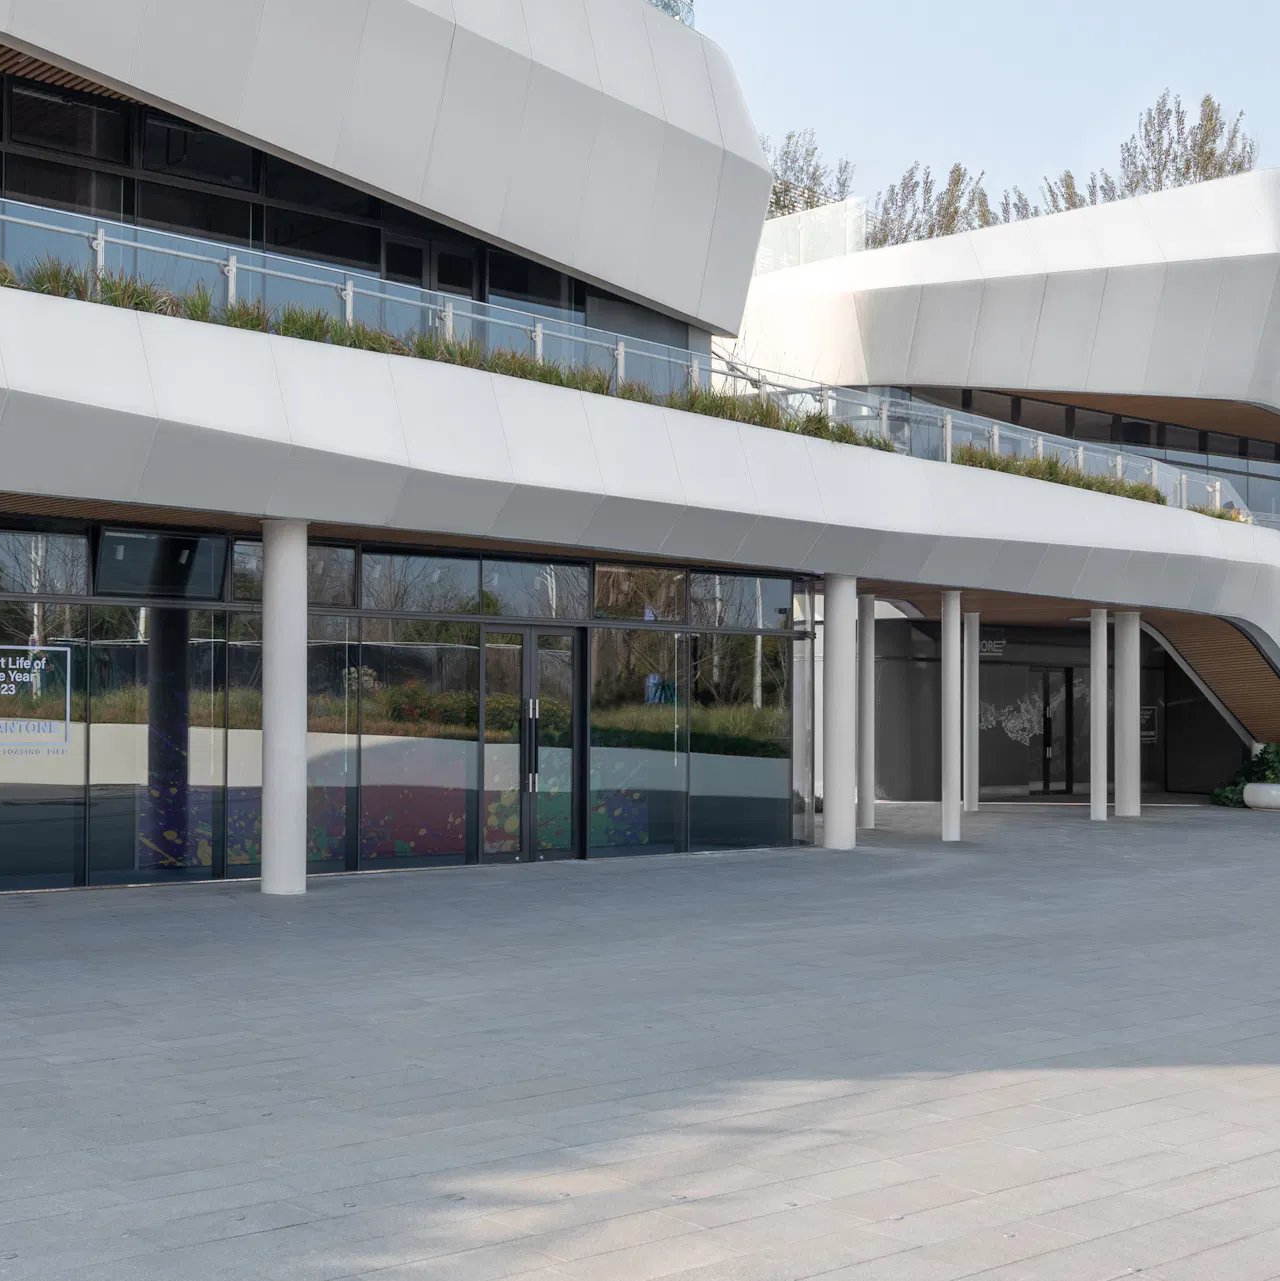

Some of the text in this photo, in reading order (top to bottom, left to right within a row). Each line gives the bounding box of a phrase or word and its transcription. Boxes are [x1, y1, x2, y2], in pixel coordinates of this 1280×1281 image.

[8, 656, 31, 669] Life
[33, 657, 47, 669] of
[8, 670, 36, 682] Year
